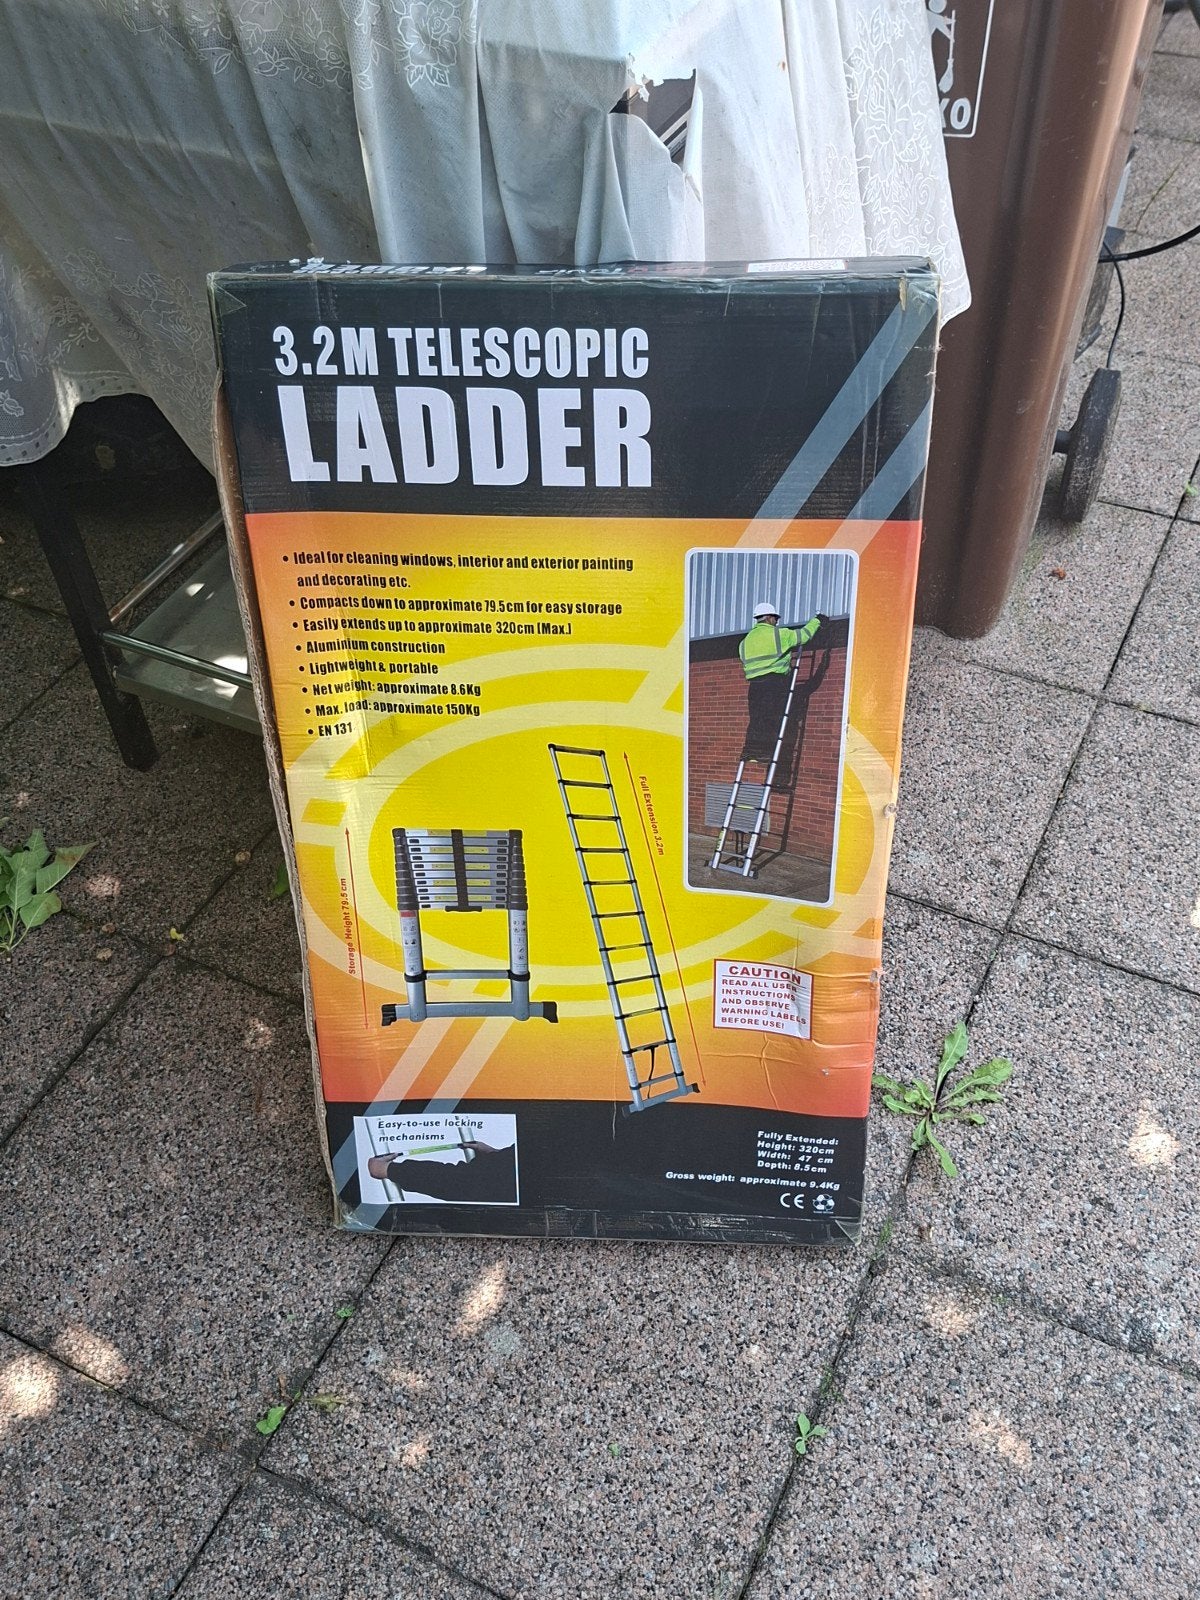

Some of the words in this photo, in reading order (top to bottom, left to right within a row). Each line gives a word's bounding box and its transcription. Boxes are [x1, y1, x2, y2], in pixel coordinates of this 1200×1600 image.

[272, 325, 379, 376] 3.2M
[387, 327, 649, 378] TELESCOPIC
[277, 385, 652, 488] LADDER
[293, 551, 325, 565] Ideal
[327, 552, 344, 564] for
[346, 551, 399, 566] cleaning
[400, 553, 456, 568] windows,
[457, 554, 504, 568] interior
[506, 556, 529, 569] and
[531, 557, 579, 570] exterior
[582, 557, 633, 572] painting
[297, 574, 319, 587] and
[322, 573, 387, 588] decorating
[389, 576, 411, 588] etc.
[300, 596, 359, 610] Compacts
[361, 596, 392, 609] down
[394, 598, 406, 610] to
[408, 599, 482, 612] approximate
[484, 600, 524, 613] 79.5cm
[526, 600, 543, 613] for
[545, 602, 573, 615] easy
[575, 602, 622, 616] storage
[303, 617, 339, 632] Easily
[341, 617, 386, 631] extends
[388, 621, 402, 632] up
[404, 620, 416, 632] to
[418, 621, 492, 633] approximate
[496, 621, 534, 634] 320cm
[306, 638, 368, 653] Aluminium
[371, 641, 445, 654] construction
[309, 659, 377, 675] Lightweight
[389, 661, 438, 674] portable
[313, 683, 333, 696] Net
[335, 679, 376, 693] weight:
[377, 682, 448, 695] approximate
[451, 683, 481, 697] 8.6Kg
[315, 704, 343, 717] Max.
[344, 699, 372, 713] load:
[373, 701, 443, 715] approximate
[446, 703, 480, 717] 150Kg
[318, 725, 332, 737] EN
[334, 721, 353, 735] 131
[639, 776, 650, 792] Full
[643, 793, 659, 834] Extension
[654, 835, 664, 856] 3.2m
[343, 911, 353, 939] Height
[348, 942, 356, 974] Storage
[728, 965, 801, 985] CAUTION
[721, 988, 796, 1001] INSTRUCTIONS
[772, 982, 797, 993] USER
[744, 999, 790, 1010] OBSERVE
[721, 1007, 768, 1016] WARNING
[770, 1010, 807, 1025] LABELS
[721, 1017, 760, 1025] BEFORE
[762, 1020, 785, 1029] USE!
[378, 1119, 440, 1130] Easy-to-use
[444, 1118, 484, 1129] locking
[378, 1133, 445, 1142] mechanisms
[757, 1130, 784, 1142] Fully
[785, 1134, 839, 1146] Extended:
[757, 1141, 796, 1152] Height:
[798, 1145, 835, 1155] 320cm
[757, 1150, 791, 1160] Width:
[798, 1154, 812, 1163] 47
[817, 1156, 834, 1164] cm
[757, 1160, 792, 1172] Depth:
[793, 1163, 827, 1173] 8.5cm
[665, 1171, 695, 1180] Gross
[697, 1172, 735, 1183] weight:
[739, 1176, 807, 1188] approximate
[809, 1180, 840, 1191] 9.4Kg
